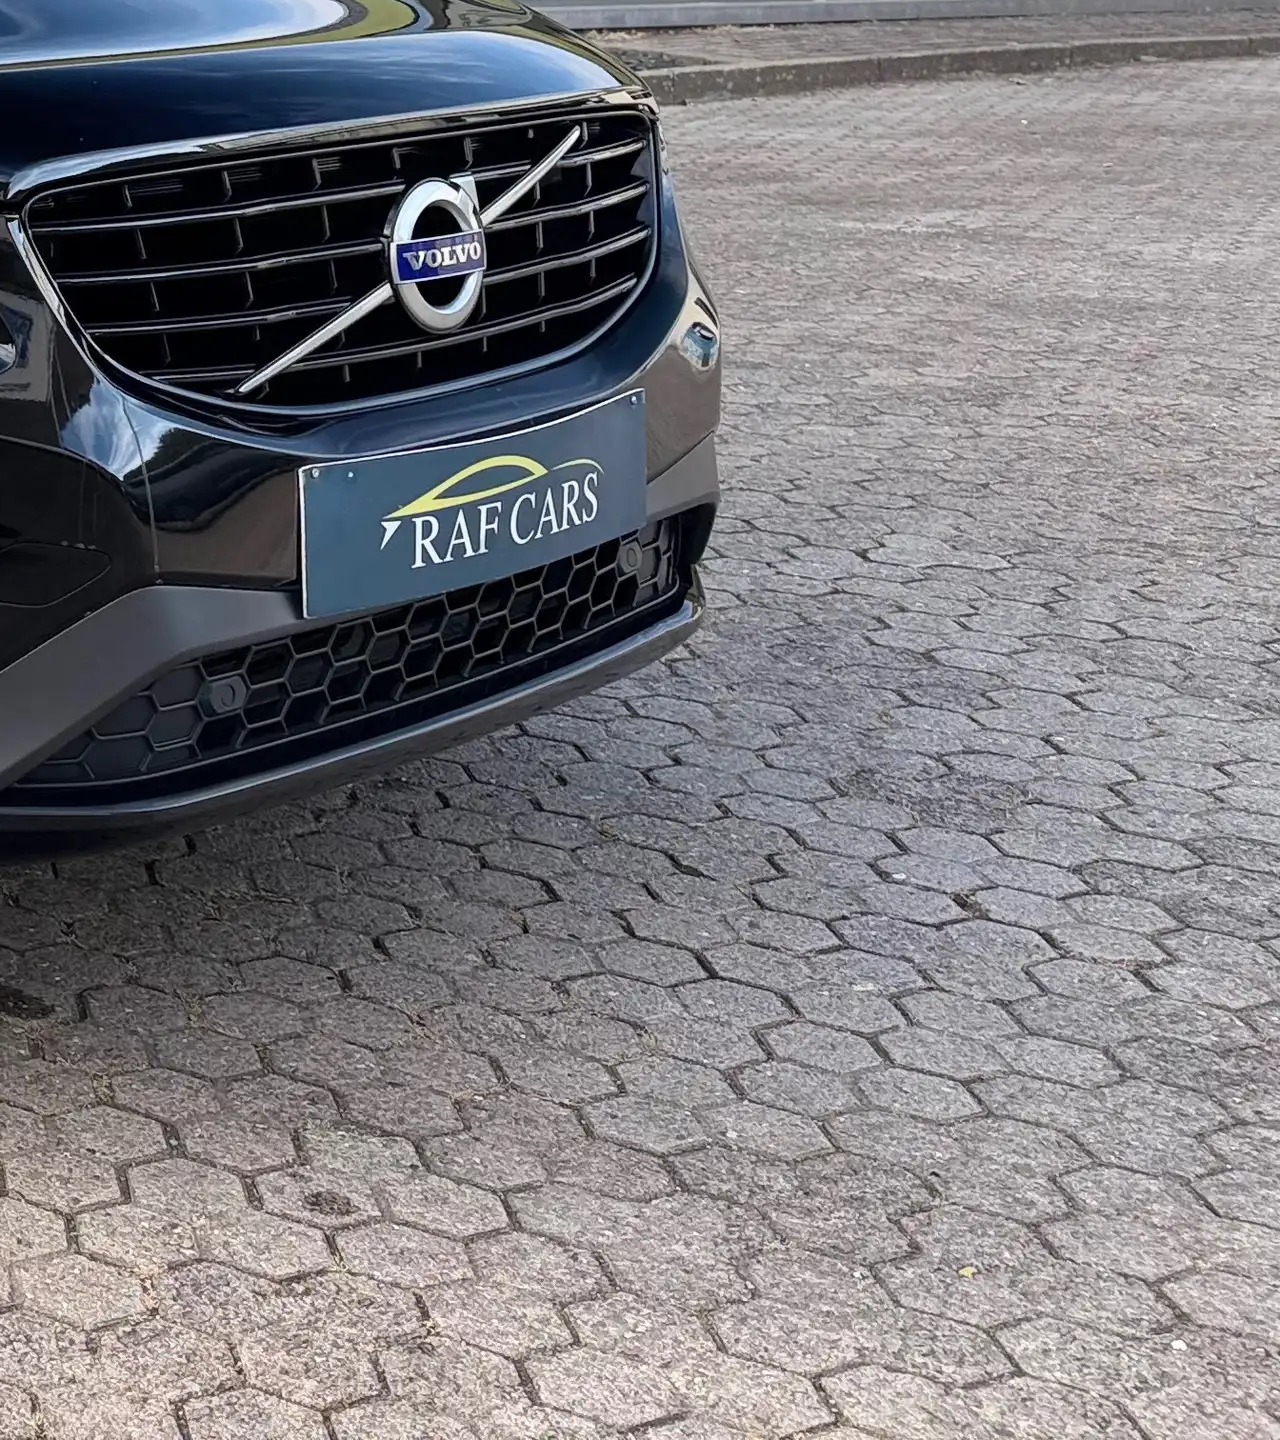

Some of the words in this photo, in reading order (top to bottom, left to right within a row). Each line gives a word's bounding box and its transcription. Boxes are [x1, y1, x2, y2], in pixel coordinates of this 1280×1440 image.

[402, 240, 482, 270] VOLVO
[411, 501, 502, 568] RAF
[510, 471, 599, 545] CARS
